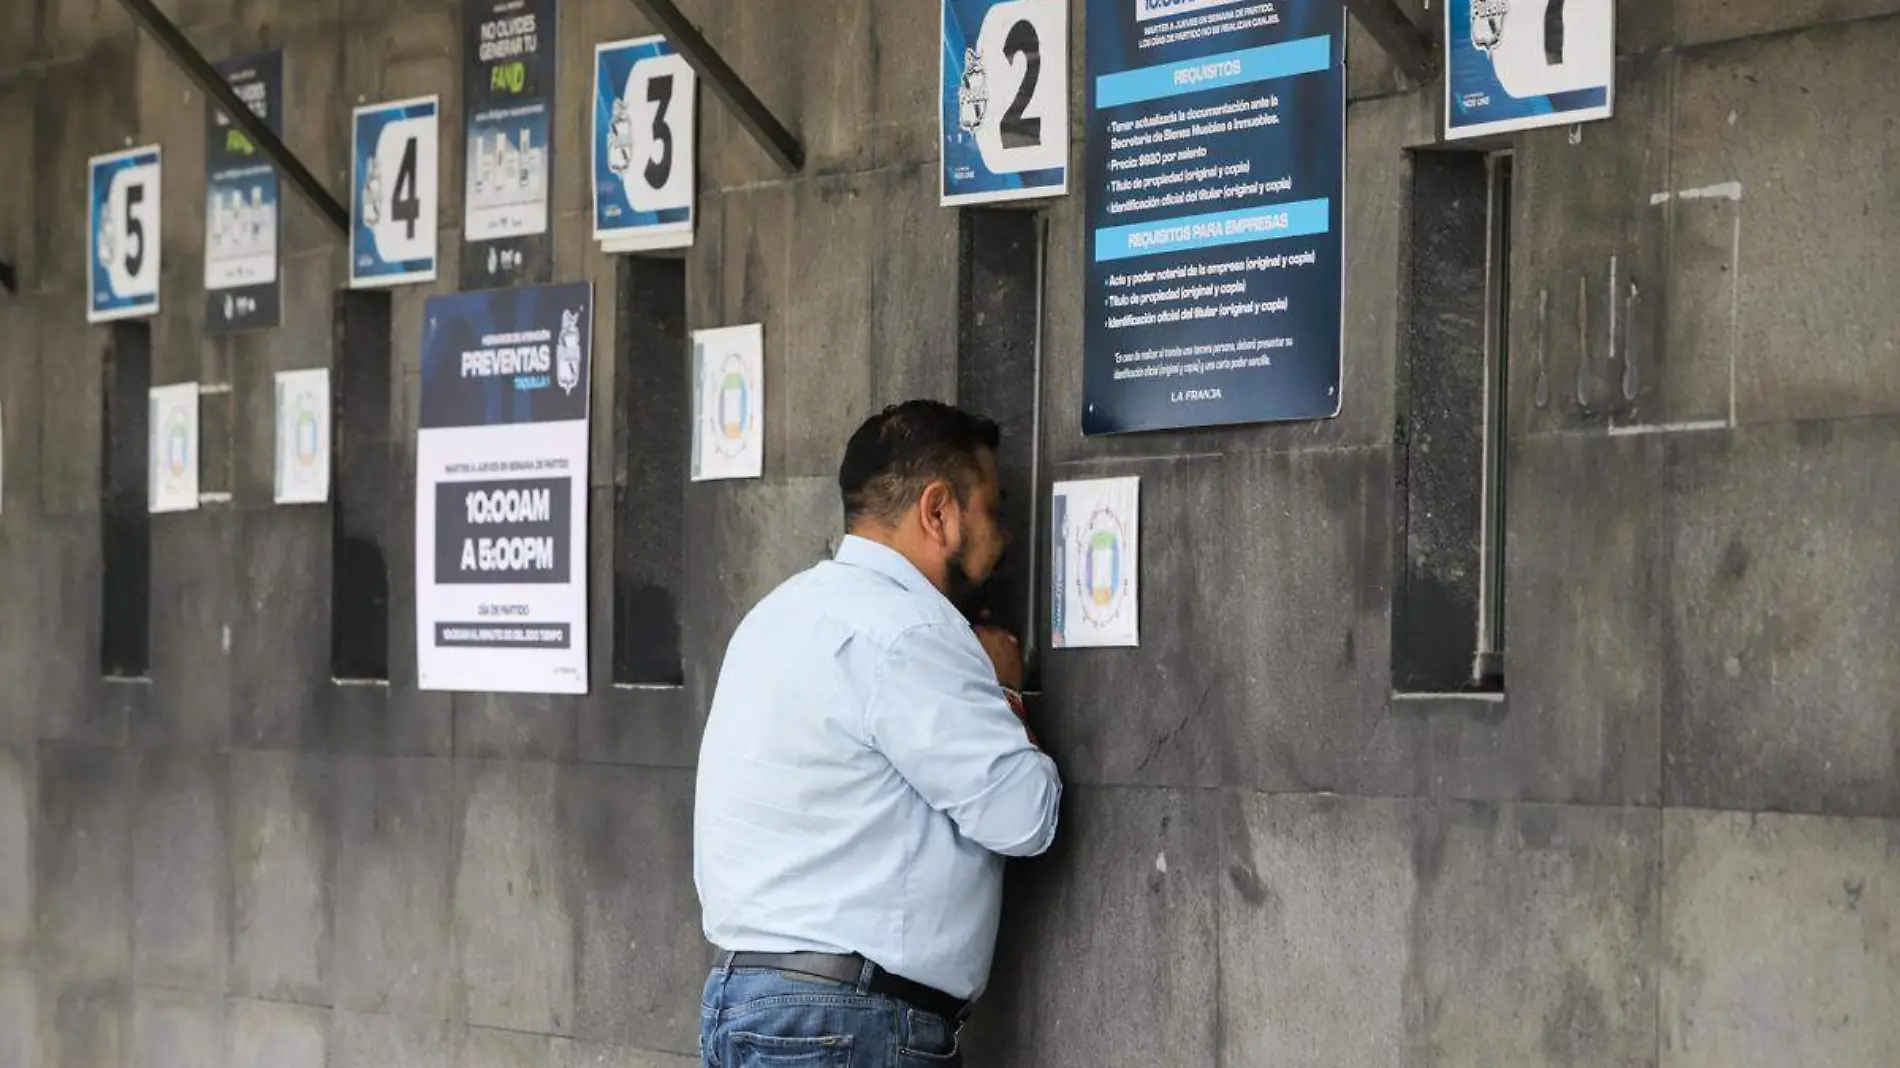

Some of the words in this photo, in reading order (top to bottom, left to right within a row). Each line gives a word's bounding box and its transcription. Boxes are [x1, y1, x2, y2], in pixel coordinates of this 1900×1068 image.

[1000, 18, 1042, 150] 2
[1173, 59, 1242, 86] REQUISITOS
[1111, 121, 1135, 134] Tener
[1134, 111, 1178, 129] actualizada
[1178, 110, 1186, 121] la
[1186, 99, 1250, 120] documentación
[1250, 96, 1270, 110] ante
[1270, 94, 1279, 107] la
[643, 74, 674, 190] 3
[1152, 130, 1163, 143] de
[1163, 127, 1192, 141] Bienes
[1192, 121, 1227, 136] Muebles
[1226, 121, 1233, 132] e
[1161, 153, 1177, 166] por
[1177, 145, 1208, 161] asiento
[390, 136, 421, 240] 4
[1133, 177, 1143, 189] de
[1143, 170, 1184, 190] propiedad
[1184, 164, 1217, 182] (original
[1217, 167, 1223, 179] y
[1224, 160, 1250, 176] copia)
[1160, 191, 1185, 206] oficial
[1185, 189, 1198, 203] del
[1198, 187, 1223, 200] titular
[1223, 181, 1258, 199] (original
[1258, 182, 1264, 196] y
[1265, 175, 1293, 193] copia)
[124, 183, 145, 278] 5
[1127, 225, 1191, 249] REQUISITOS
[1192, 220, 1223, 240] PARA
[1224, 212, 1289, 236] EMPRESAS
[1109, 274, 1127, 286] Acta
[1126, 276, 1132, 287] y
[1131, 270, 1157, 287] poder
[1157, 265, 1187, 281] notarial
[1187, 264, 1198, 276] de
[1198, 263, 1206, 275] la
[1206, 261, 1245, 276] empresa
[1246, 253, 1281, 272] (original
[1281, 256, 1287, 269] y
[1288, 249, 1316, 267] copia)
[1129, 292, 1140, 305] de
[1140, 287, 1180, 306] propiedad
[1180, 283, 1214, 300] (original
[1213, 284, 1220, 298] y
[1220, 278, 1247, 296] copia)
[1157, 308, 1181, 324] oficial
[1180, 306, 1193, 321] del
[1193, 305, 1219, 319] titular
[1219, 300, 1253, 318] (original
[1254, 302, 1261, 316] y
[1261, 295, 1289, 314] copia)
[461, 344, 551, 378] PREVENTAS
[1171, 391, 1184, 403] LA
[1185, 387, 1222, 401] FRANJA
[465, 488, 551, 525] 10:00AM
[461, 537, 478, 572] A
[477, 536, 554, 572] 5:00PM
